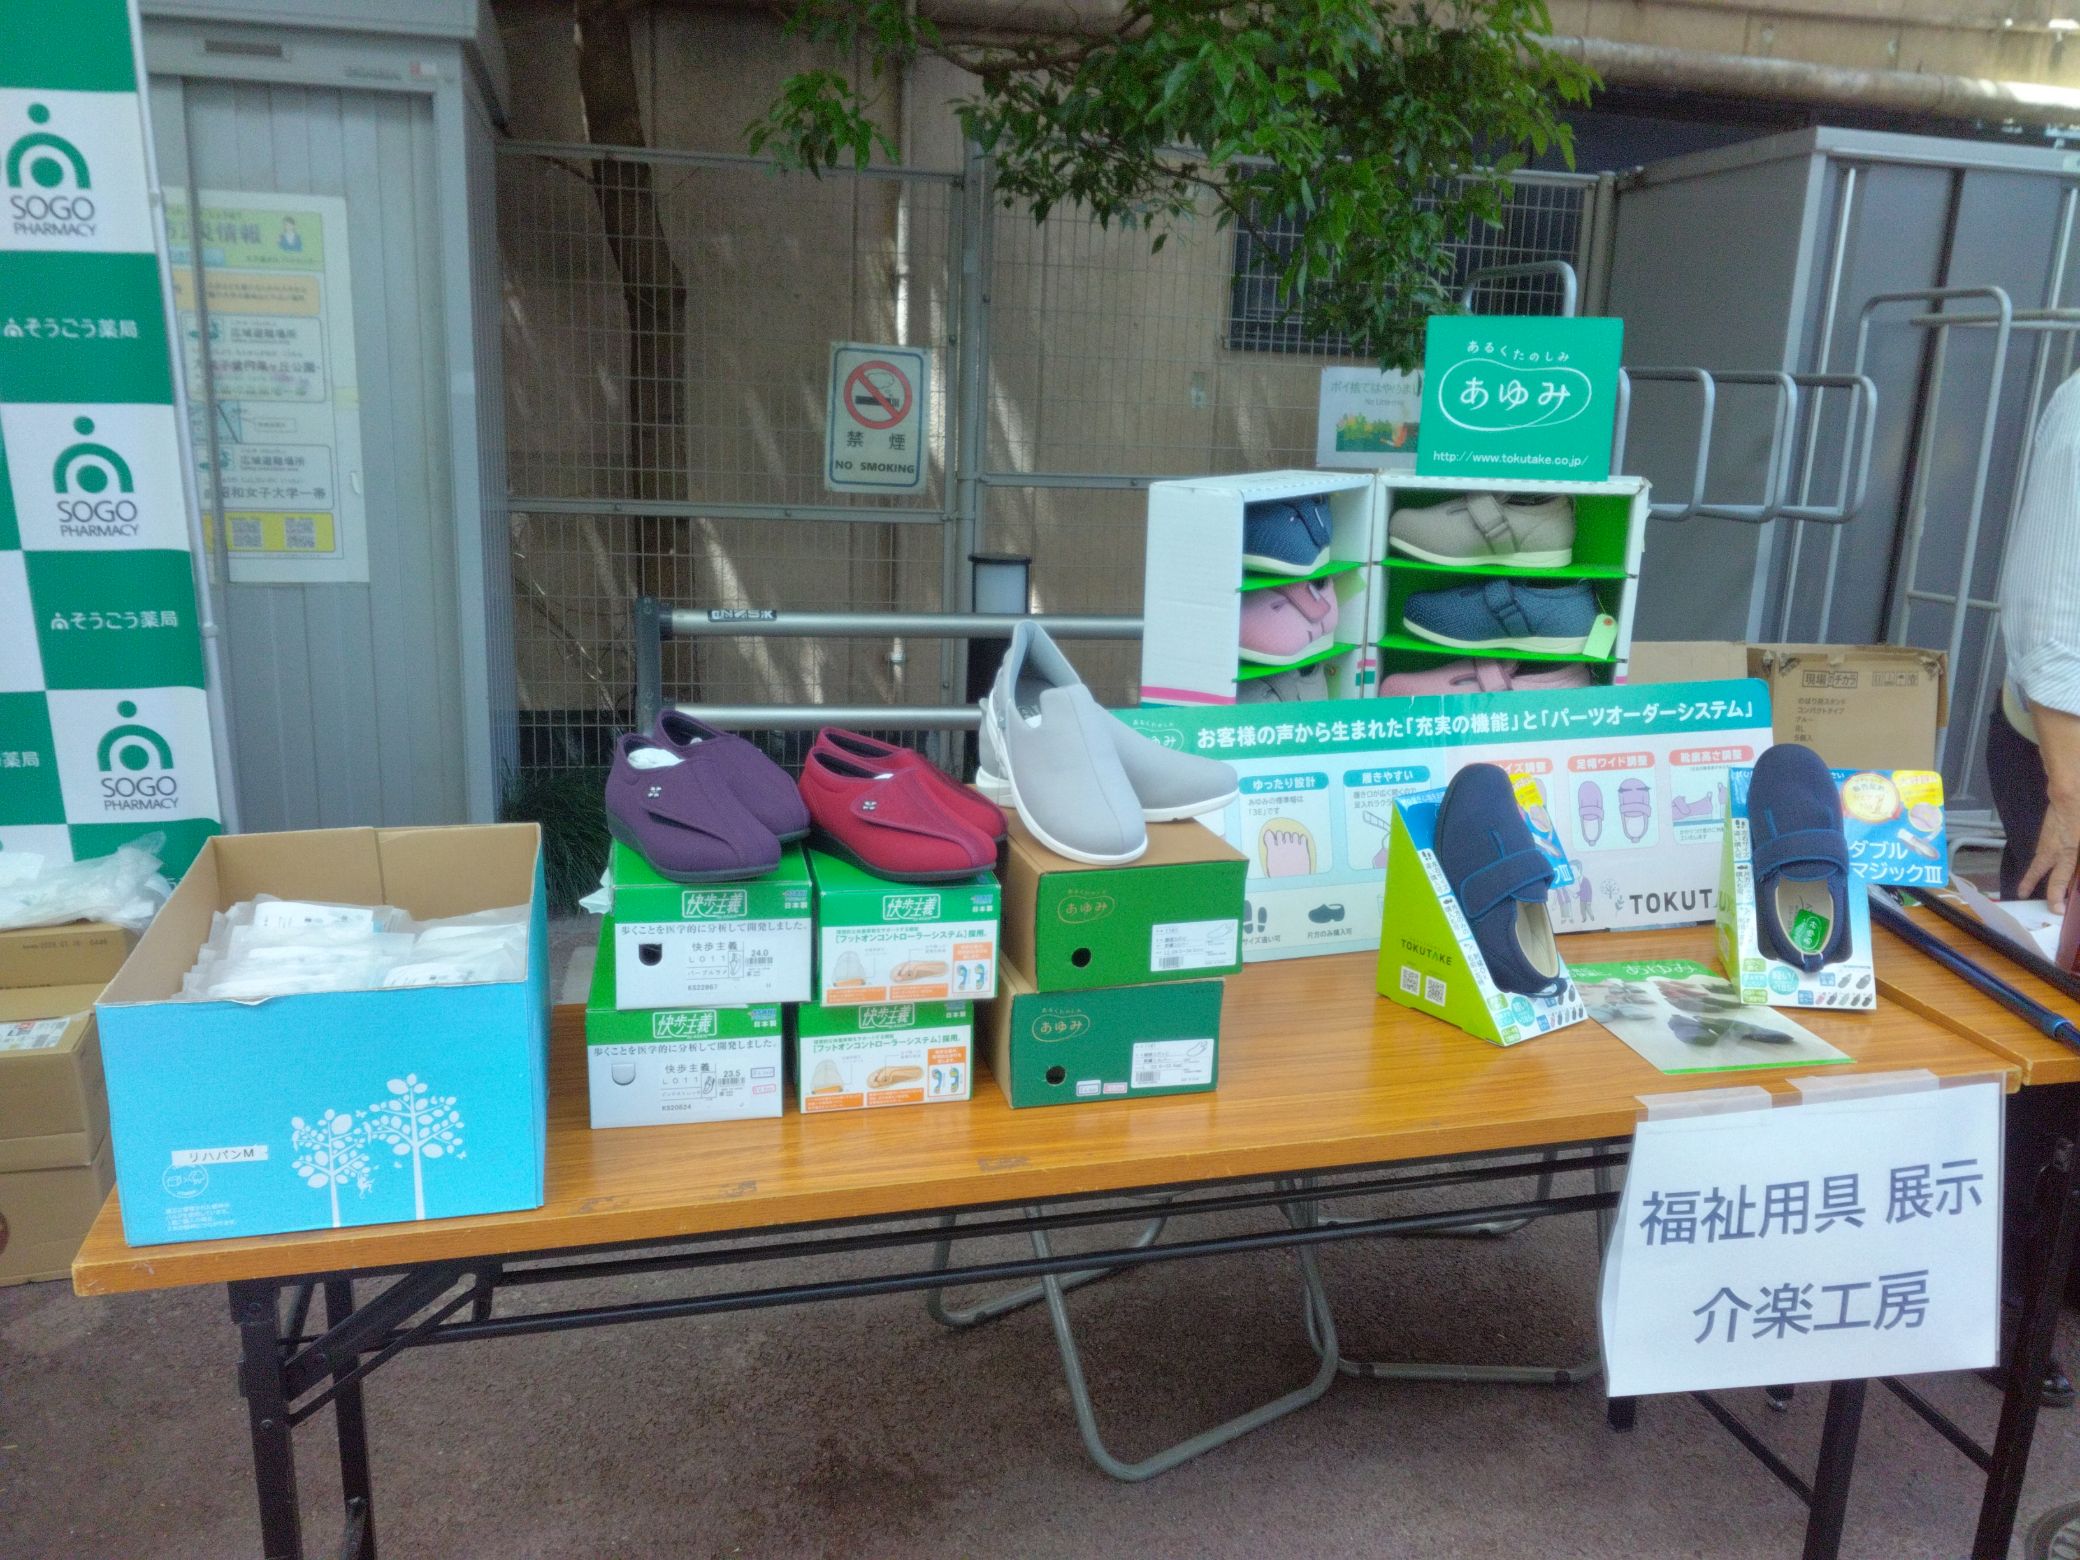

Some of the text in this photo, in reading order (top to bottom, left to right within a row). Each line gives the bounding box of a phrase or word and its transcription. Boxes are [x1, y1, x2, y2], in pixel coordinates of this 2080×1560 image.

[10, 195, 95, 221] SOGO
[13, 222, 97, 237] PHARMACY
[1466, 340, 1570, 362] あるくたのしみ
[1459, 376, 1571, 412] あゆみ
[835, 459, 915, 474] NO SMOKING
[1433, 450, 1589, 468] http://www.tokutake.co.jp/
[56, 499, 138, 523] SOGO
[59, 523, 140, 537] PHARMACY
[100, 775, 178, 798] SOGO
[1252, 776, 1316, 791] ゆったり設計
[103, 798, 179, 811] PHARMACY
[1848, 840, 1909, 859] ダブル
[1065, 901, 1108, 916] あゆみ
[1629, 888, 1716, 914] TOKUT
[1400, 938, 1453, 966] TOKUTAKE
[1040, 1021, 1083, 1035] あゆみ
[1639, 1158, 1984, 1246] 福祉用具 展示
[1693, 1269, 1930, 1344] 介楽工房
